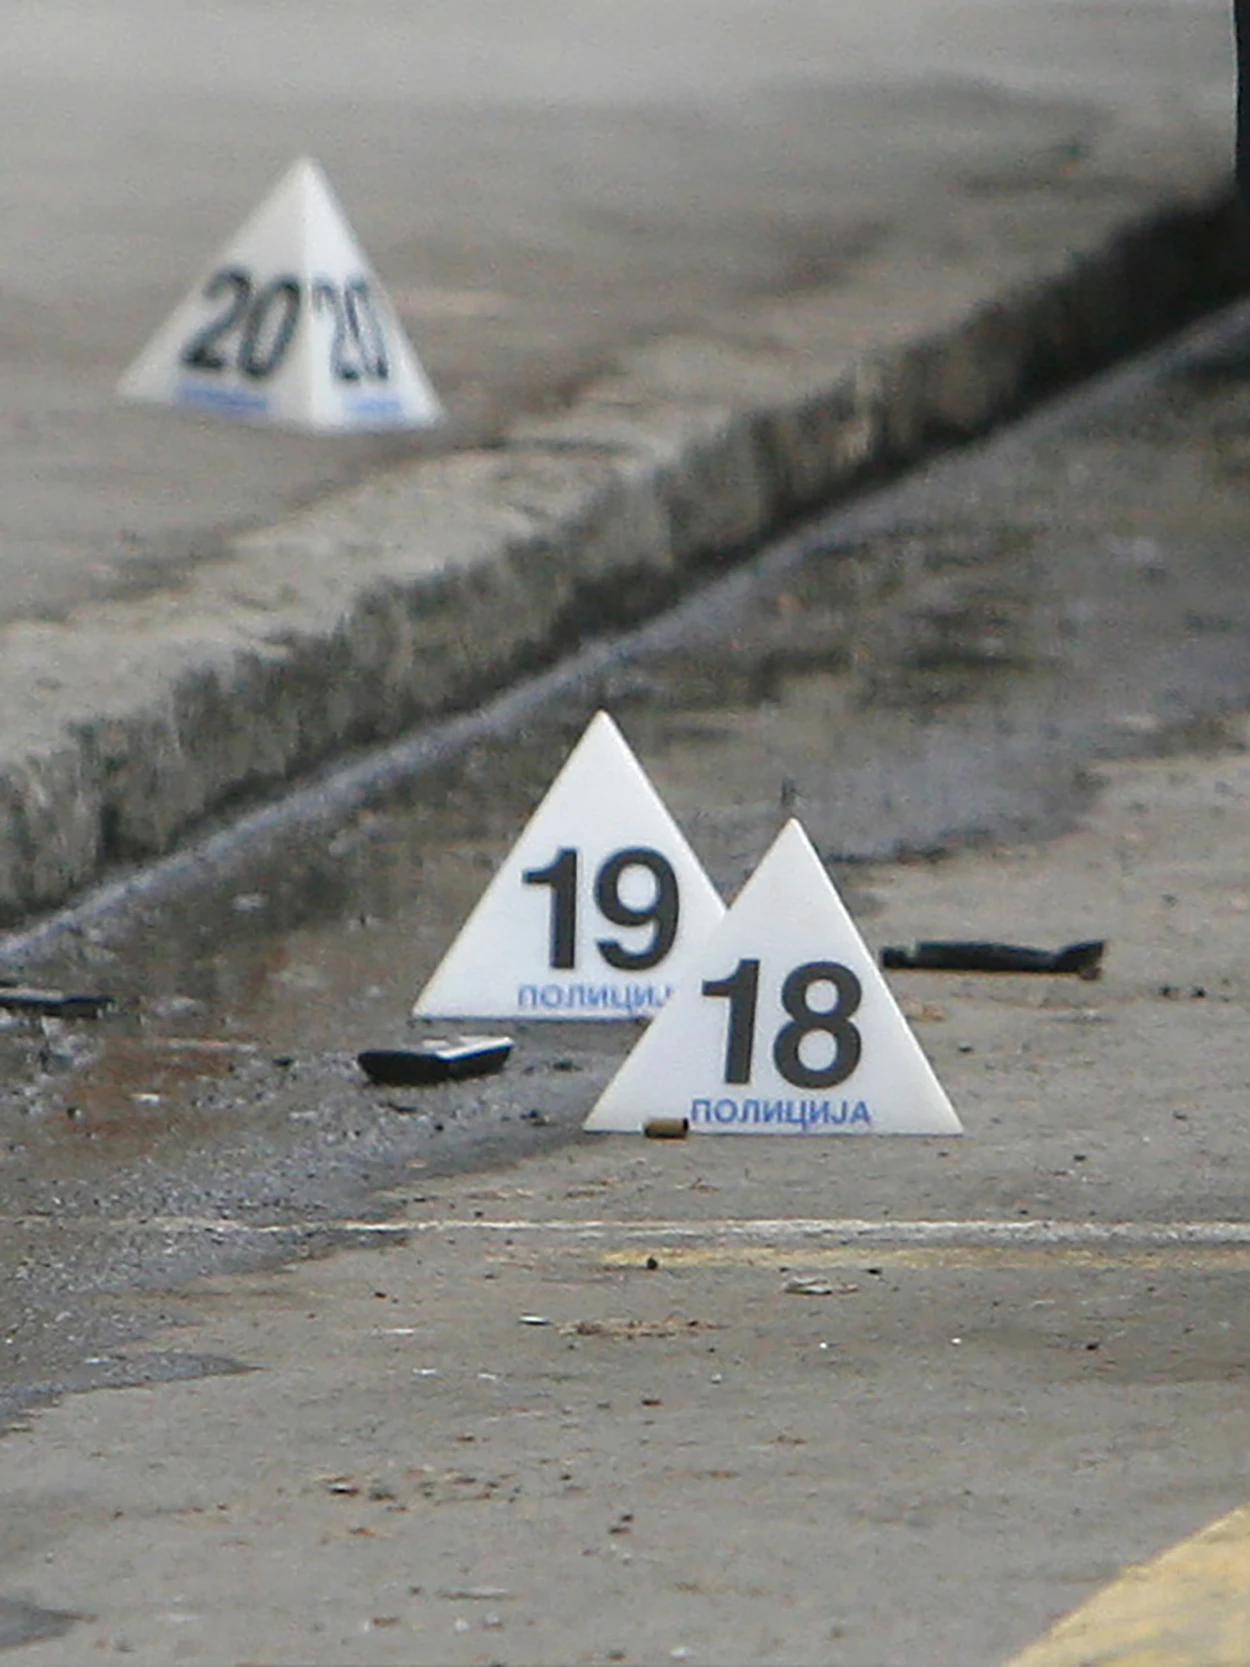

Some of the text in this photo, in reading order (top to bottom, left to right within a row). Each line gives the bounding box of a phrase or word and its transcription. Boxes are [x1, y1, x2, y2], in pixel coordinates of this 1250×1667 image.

[181, 266, 300, 379] 20
[312, 275, 388, 381] 20
[522, 847, 679, 971] 19
[702, 958, 862, 1089] 18
[691, 1098, 872, 1130] ПОЛИЦИЈА
